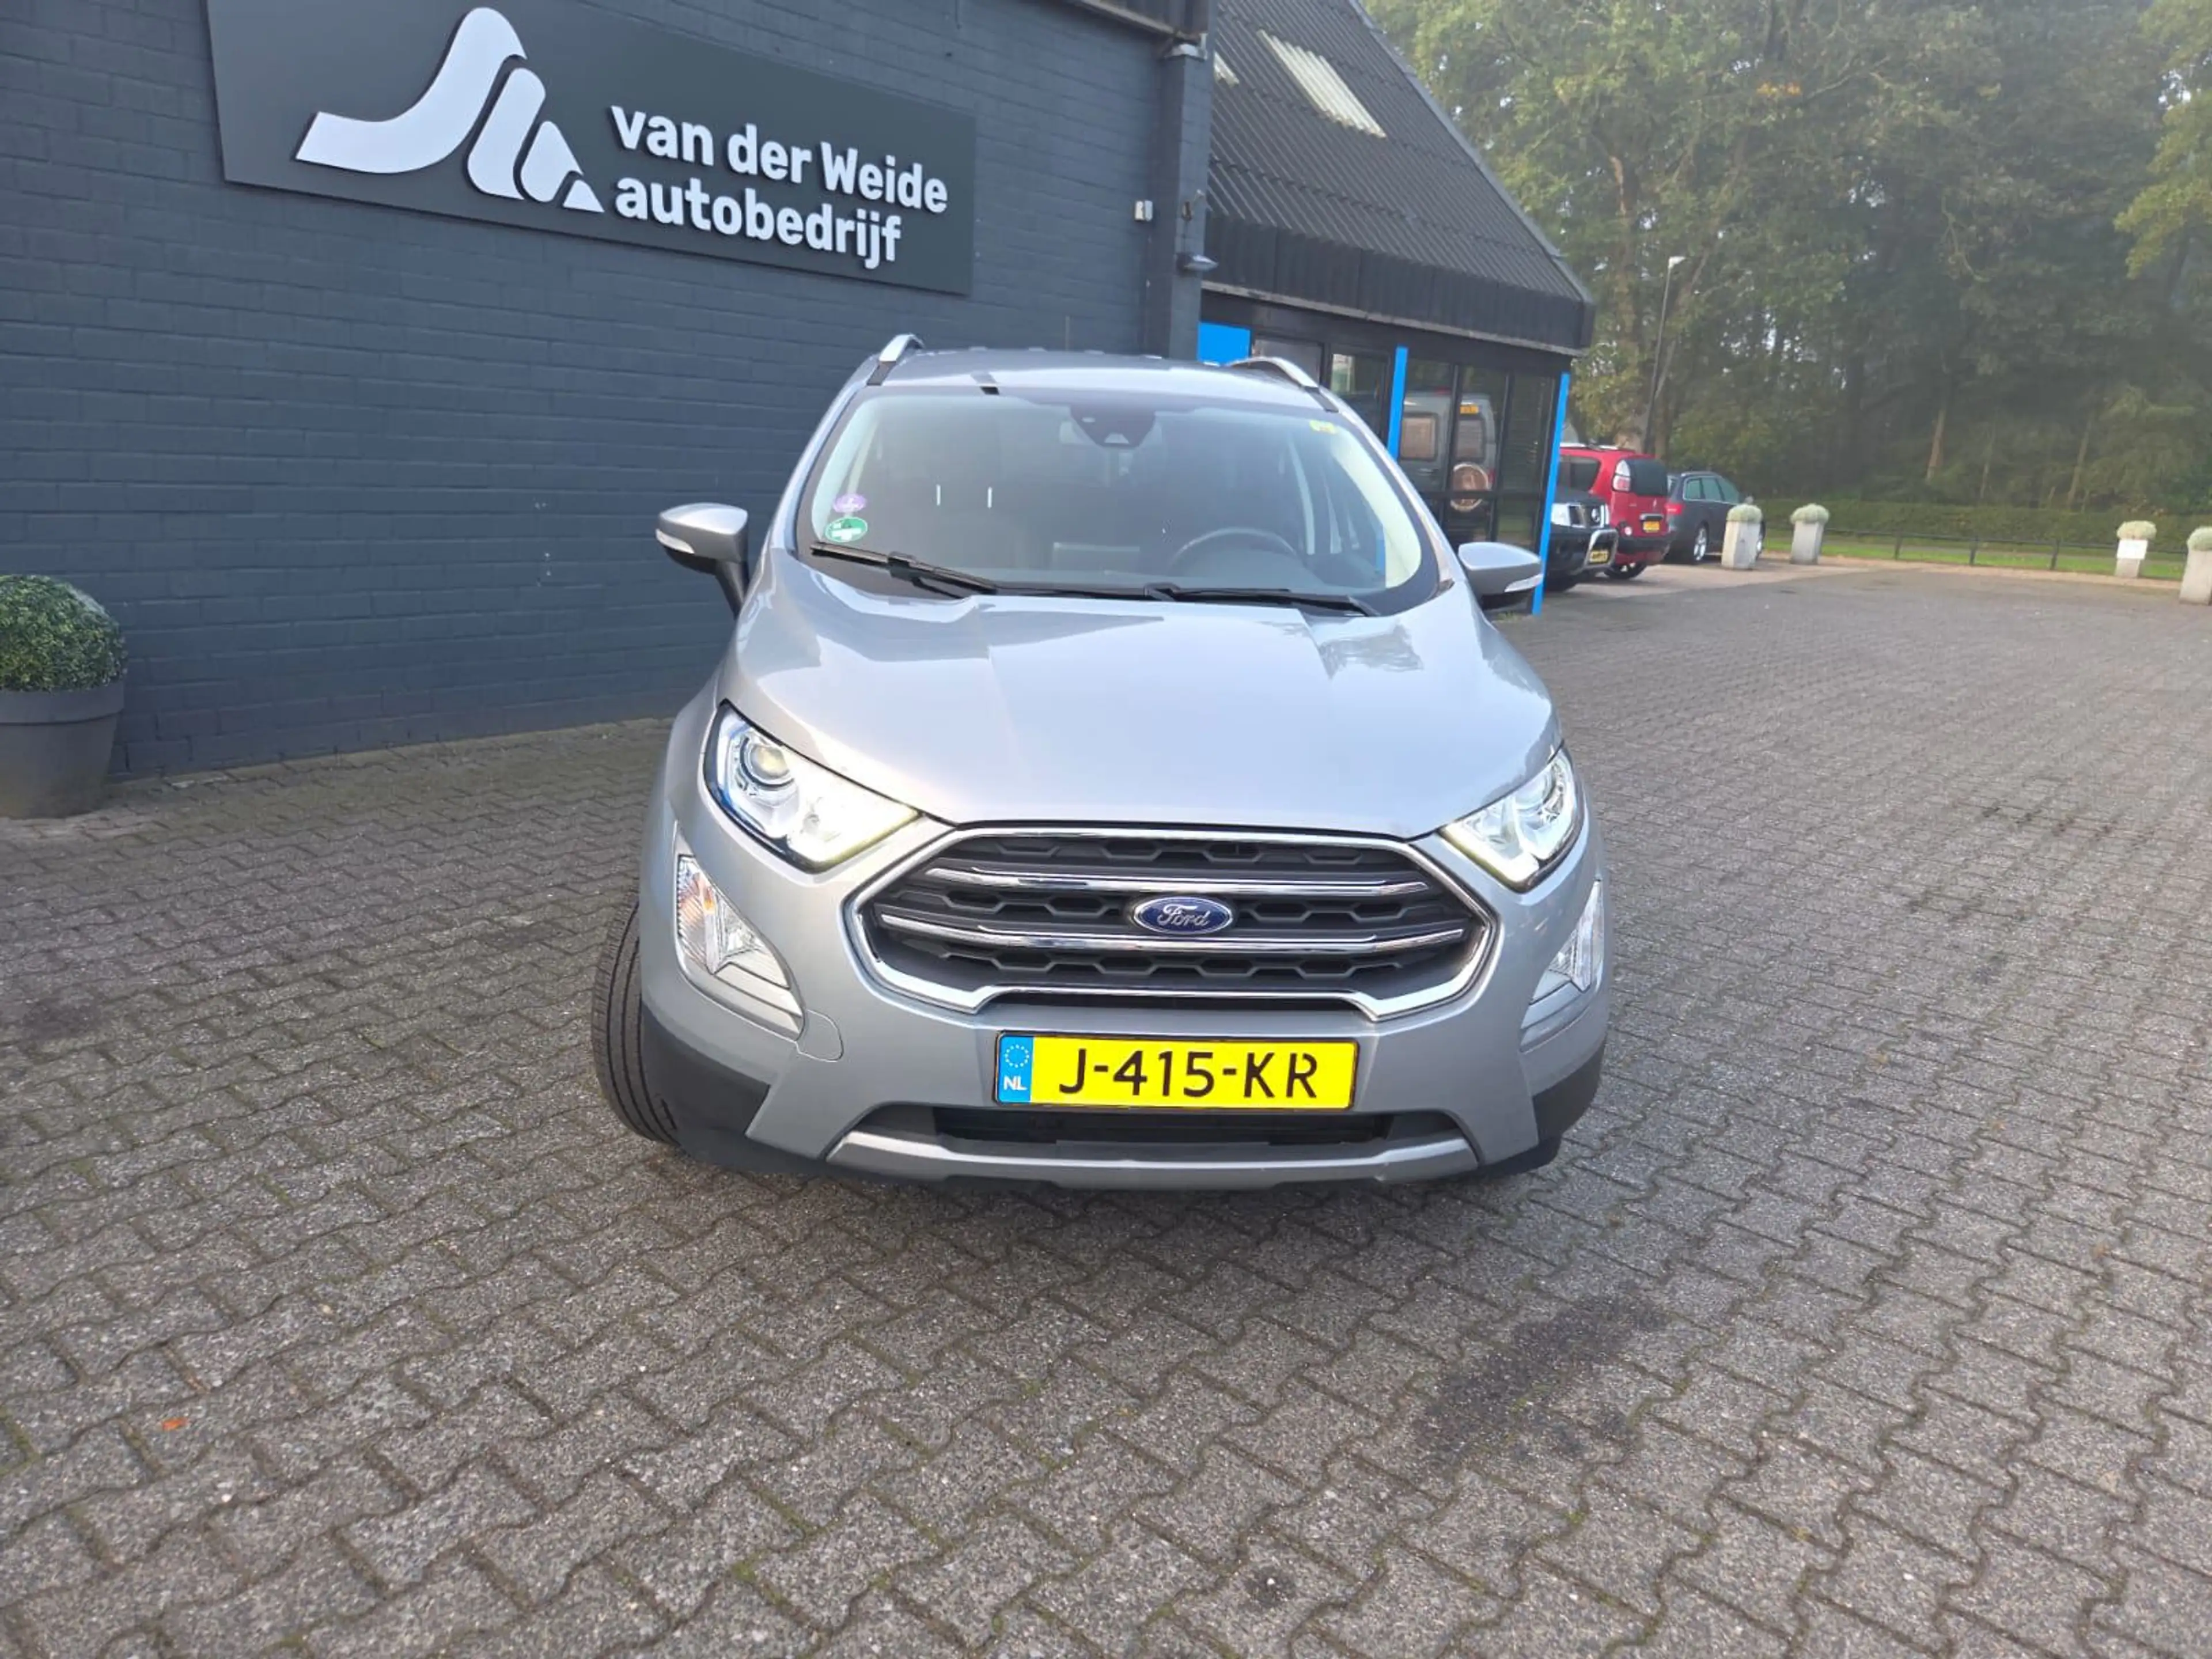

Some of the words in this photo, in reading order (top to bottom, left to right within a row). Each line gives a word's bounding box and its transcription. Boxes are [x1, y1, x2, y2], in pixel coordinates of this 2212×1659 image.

[611, 106, 714, 166] van
[728, 124, 812, 183] der
[821, 142, 948, 213] Weide
[615, 177, 901, 269] autobedrijf
[1157, 904, 1209, 927] Ford
[1003, 1076, 1027, 1091] NL
[1059, 1049, 1317, 1098] J-415-KR
